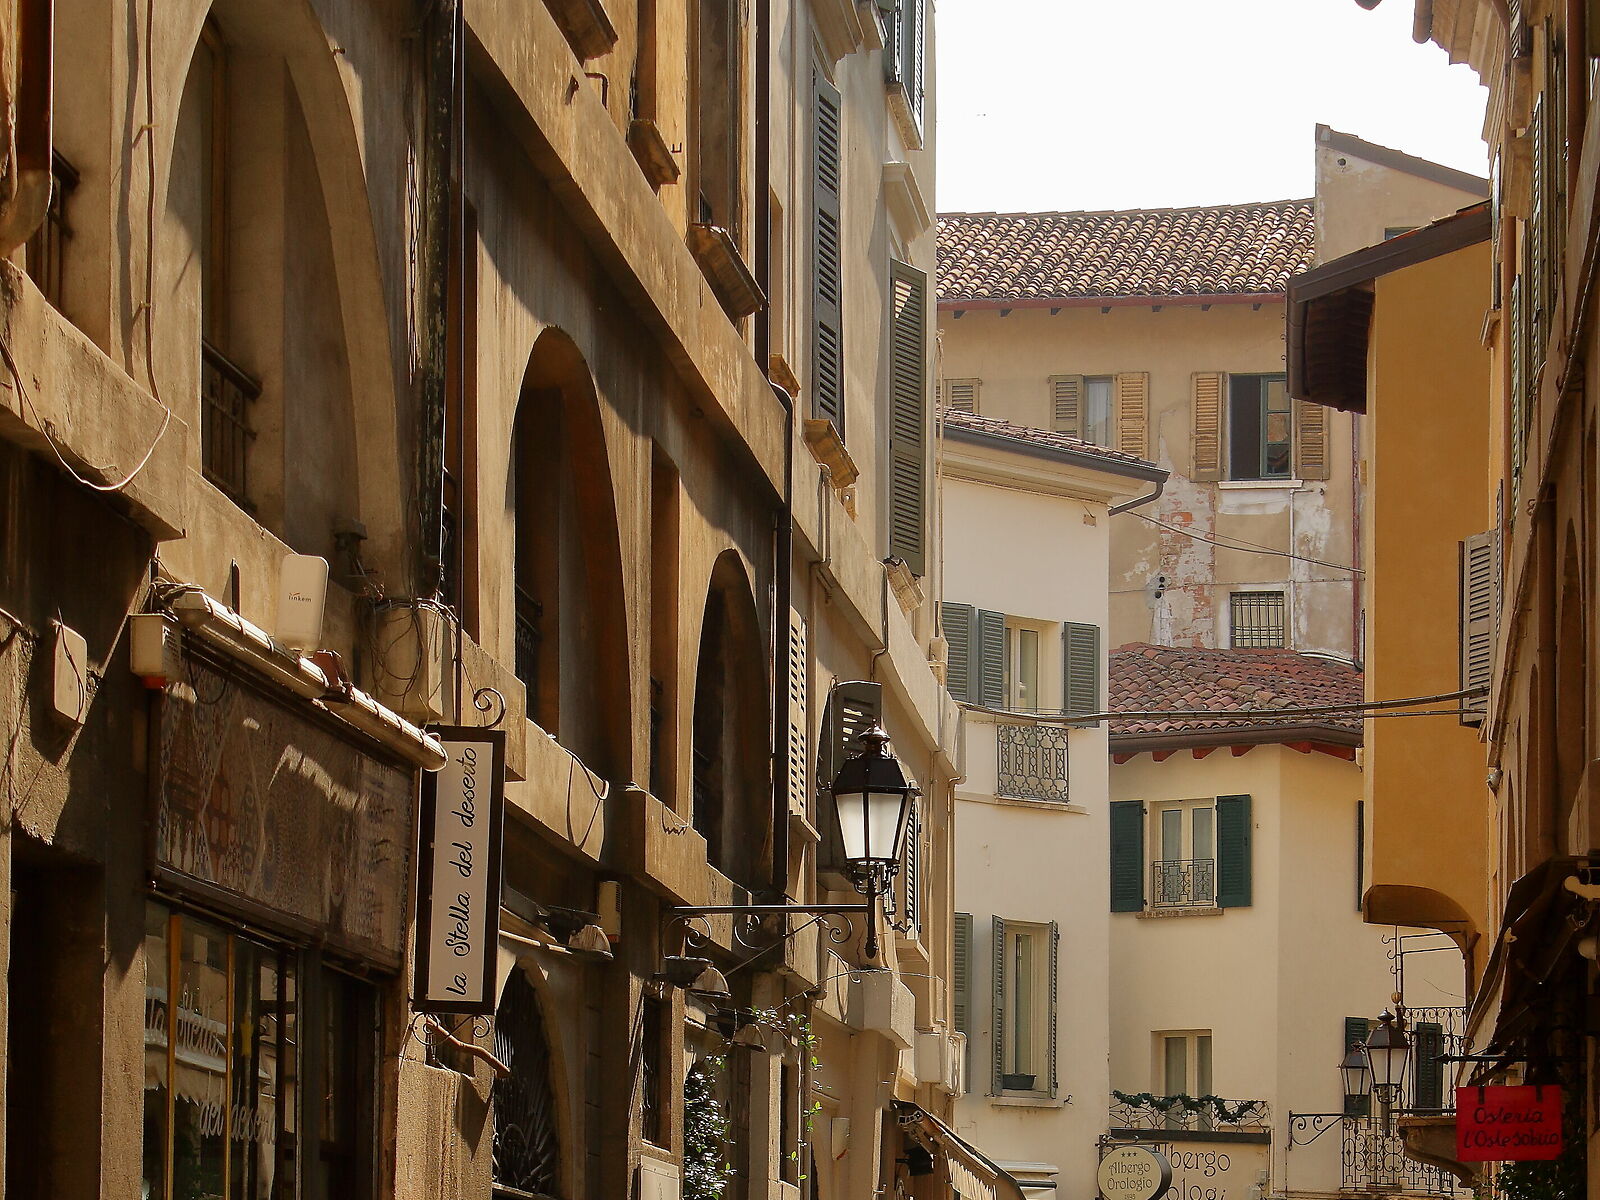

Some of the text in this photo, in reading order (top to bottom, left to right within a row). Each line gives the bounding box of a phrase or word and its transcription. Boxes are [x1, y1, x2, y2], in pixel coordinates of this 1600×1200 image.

[445, 747, 477, 996] la Stella del deserto
[1473, 1106, 1544, 1125] Osteria
[1109, 1161, 1151, 1176] Albergo
[1107, 1176, 1153, 1192] Orologio
